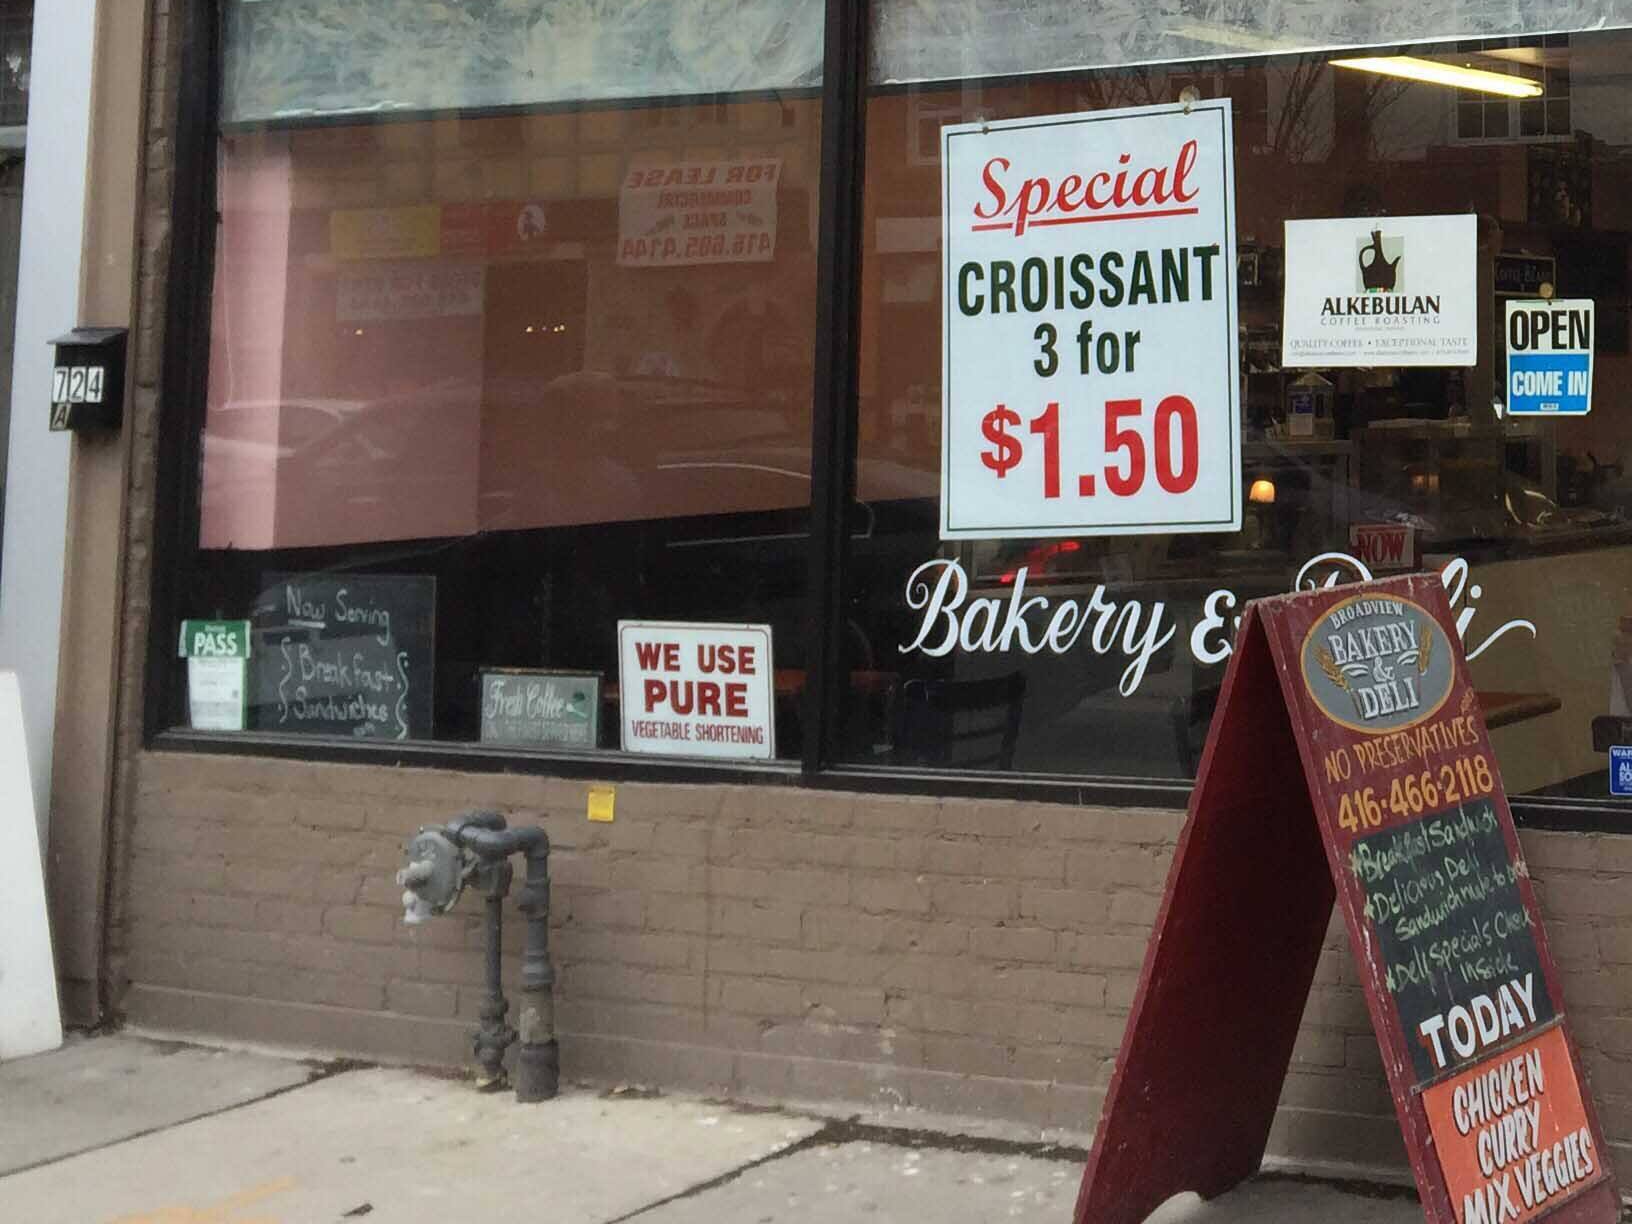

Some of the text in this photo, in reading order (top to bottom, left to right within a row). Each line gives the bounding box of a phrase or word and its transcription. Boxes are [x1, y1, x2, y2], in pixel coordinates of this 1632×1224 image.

[972, 140, 1199, 236] Special
[958, 243, 1220, 316] CROISSANT
[1321, 296, 1440, 316] ALKEBULAN
[1321, 315, 1440, 326] COFFEE ROASTING
[1033, 320, 1140, 377] 3 for
[1510, 310, 1590, 351] OPEN
[56, 370, 102, 402] 724
[1512, 370, 1587, 396] COME IN
[980, 395, 1198, 499] $1.50
[1357, 532, 1405, 563] NOW
[286, 584, 326, 620] Now
[1329, 600, 1404, 629] BROADVIEW
[194, 631, 238, 656] PASS
[898, 556, 1176, 696] Bakery
[1328, 620, 1419, 665] BAKERY
[635, 642, 756, 675] WE USE
[1373, 656, 1395, 682] &
[643, 679, 749, 718] PURE
[1359, 677, 1419, 719] DELI
[632, 720, 764, 745] VEGETABLE SHORTENING
[1324, 715, 1479, 784] NO PRESERVATIVES
[1419, 972, 1537, 1068] TODAY
[1453, 1048, 1544, 1137] CHICKEN
[1478, 1101, 1540, 1177] CURRY
[1514, 1127, 1594, 1209] VEGGIES
